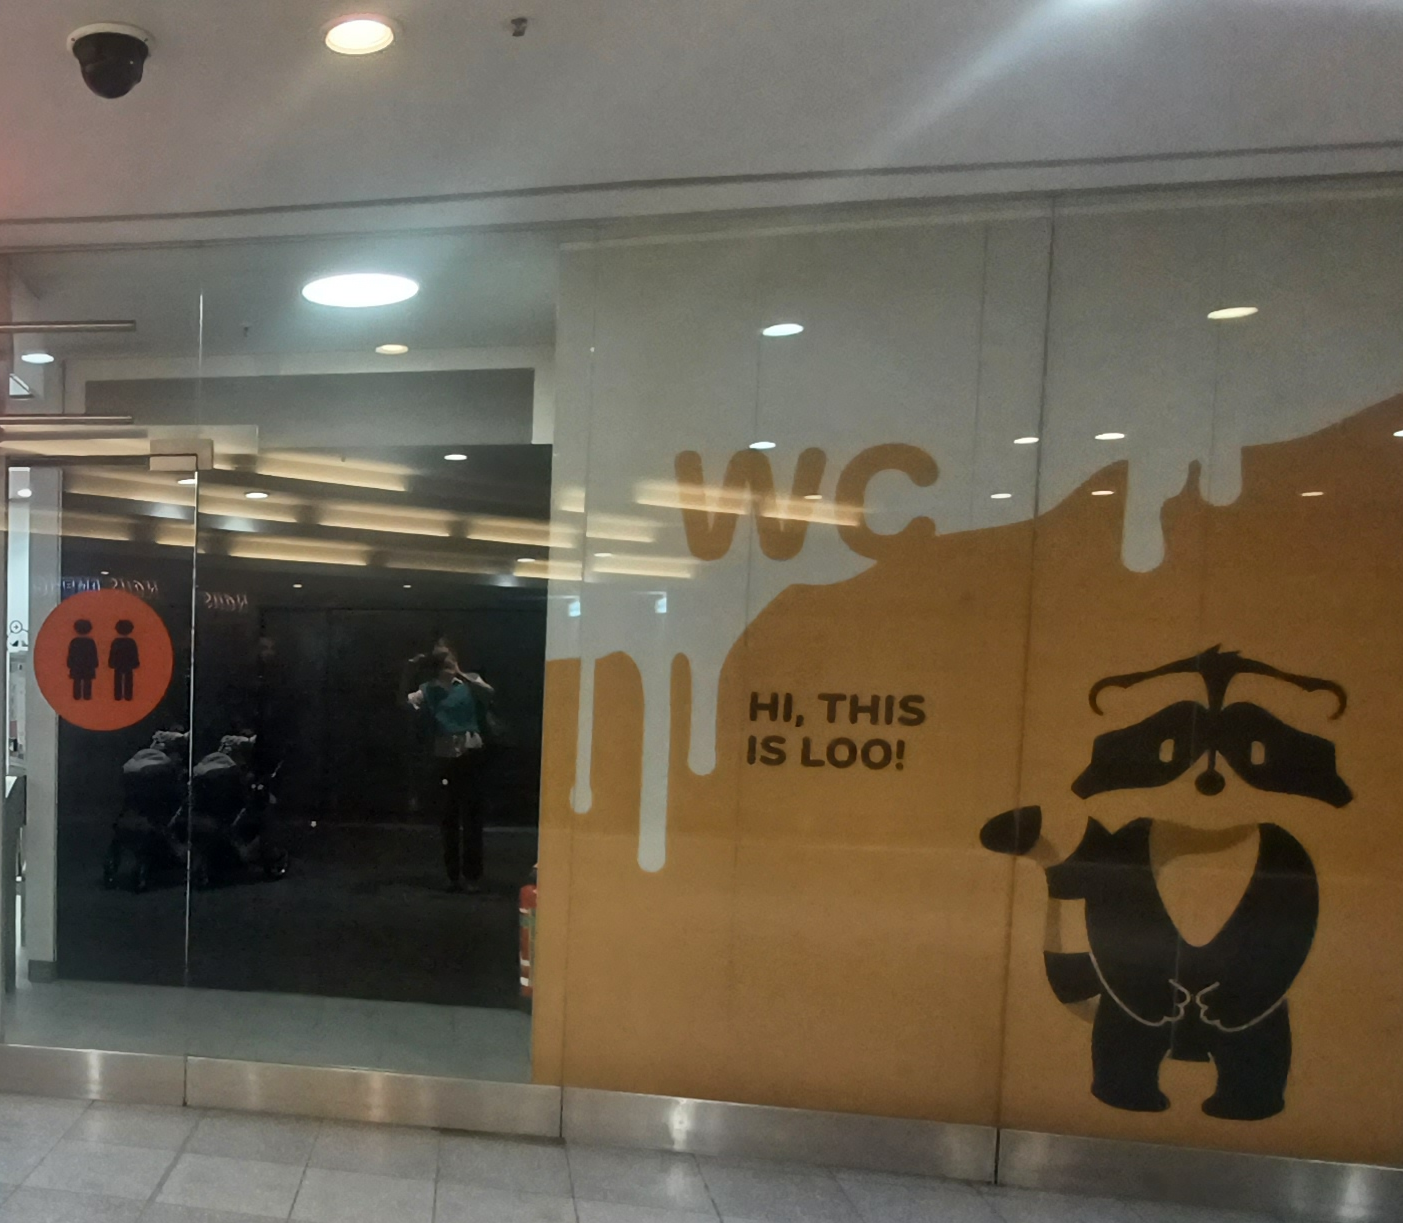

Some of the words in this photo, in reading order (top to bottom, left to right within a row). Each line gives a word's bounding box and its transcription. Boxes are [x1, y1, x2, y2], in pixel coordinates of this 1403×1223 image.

[674, 442, 940, 562] WC
[749, 691, 805, 728] HI,
[817, 692, 927, 727] THIS
[747, 735, 787, 766] IS
[800, 736, 906, 771] LOO!
